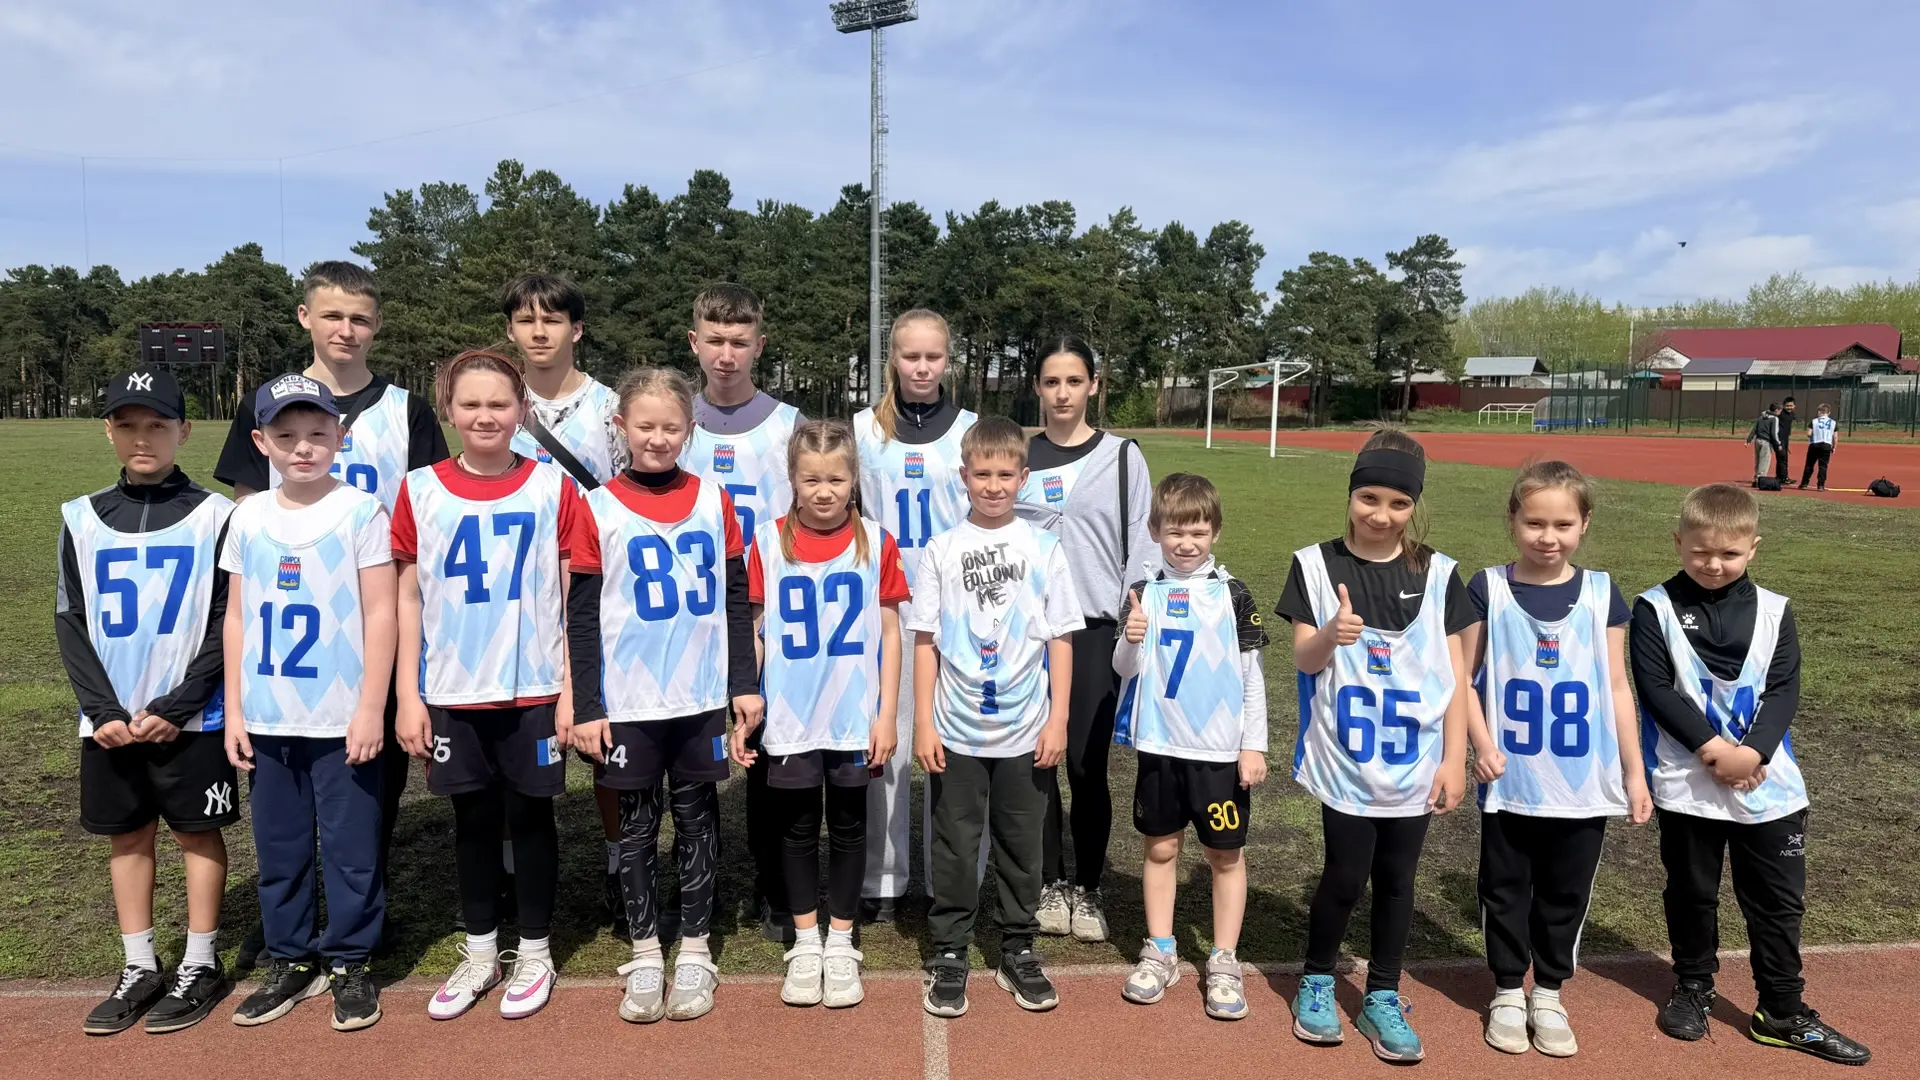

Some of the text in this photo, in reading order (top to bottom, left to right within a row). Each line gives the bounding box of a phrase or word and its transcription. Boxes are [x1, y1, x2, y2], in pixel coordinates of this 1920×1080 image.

[126, 371, 154, 392] NY
[1818, 418, 1832, 430] 54
[895, 488, 932, 548] 11
[95, 546, 195, 638] 57
[280, 556, 301, 564] СВИРСК
[444, 512, 536, 604] 47
[627, 530, 717, 622] 83
[257, 602, 321, 679] 12
[779, 570, 865, 660] 92
[980, 680, 1000, 715] 1
[1160, 628, 1194, 700] 7
[1336, 684, 1422, 766] 65
[1504, 678, 1590, 758] 98
[203, 781, 233, 816] NY
[1207, 800, 1240, 832] 30
